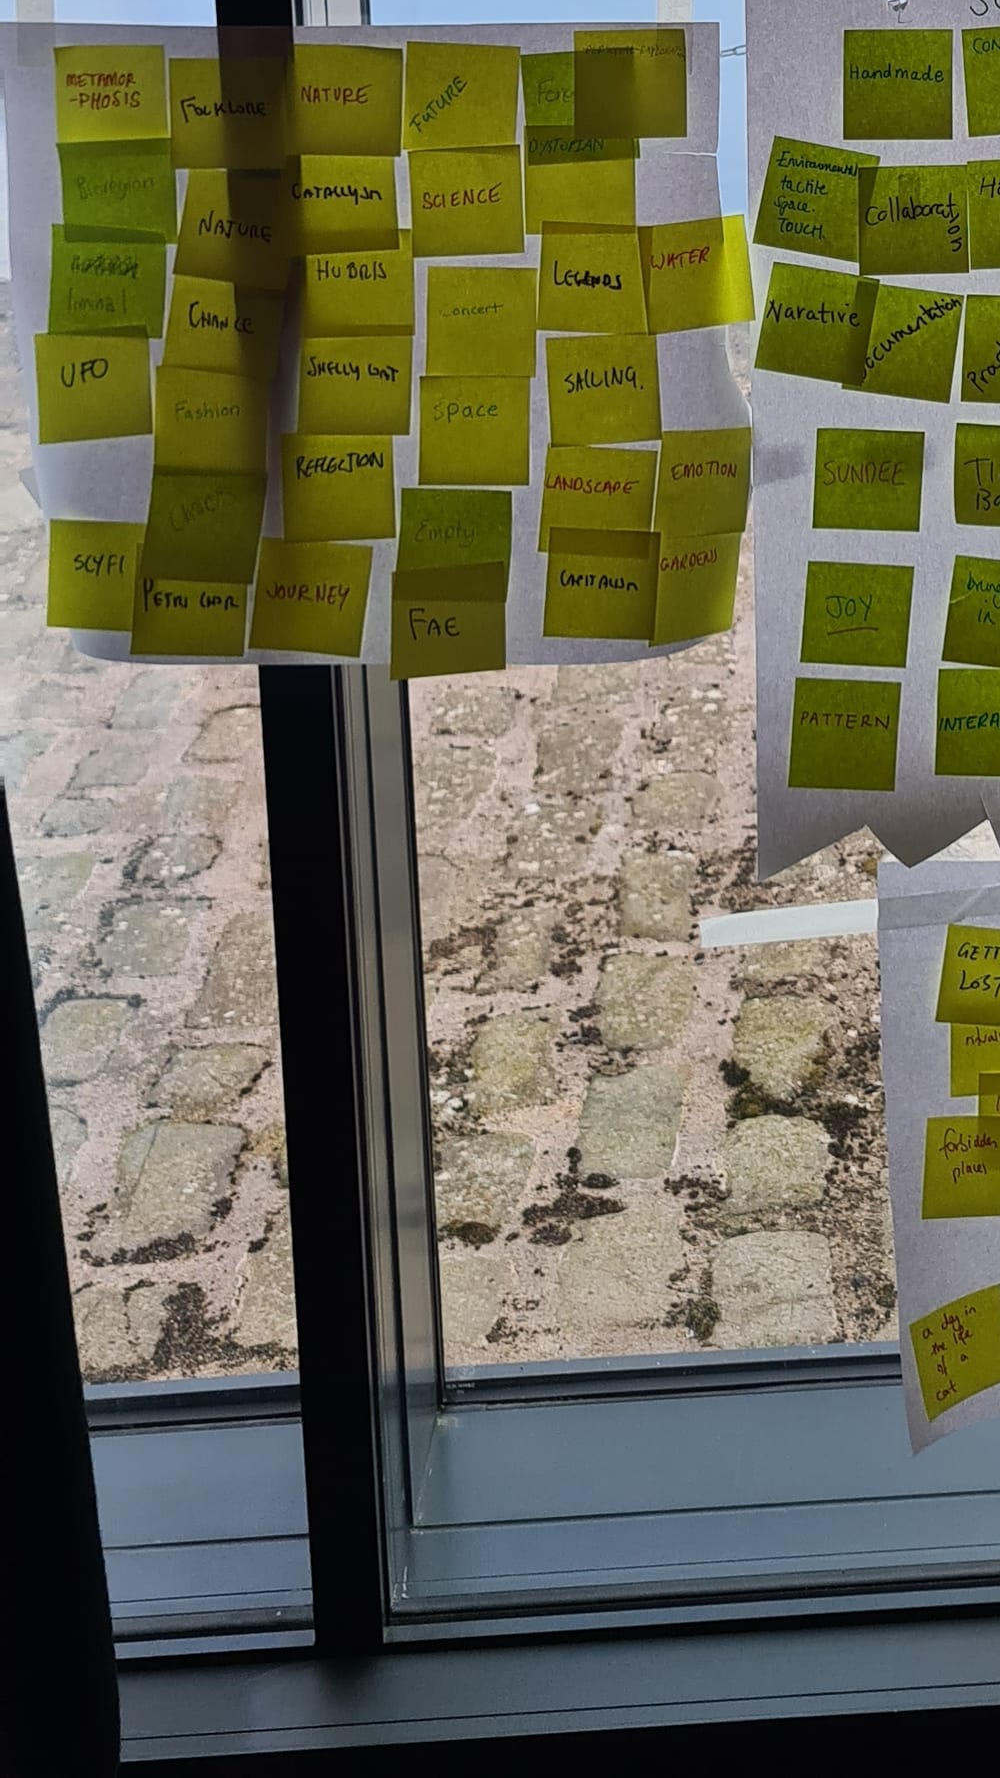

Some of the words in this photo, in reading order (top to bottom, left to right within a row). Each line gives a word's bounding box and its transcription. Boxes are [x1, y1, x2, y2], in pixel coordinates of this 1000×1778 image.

[849, 61, 946, 84] Handmade
[300, 83, 374, 106] NATURE
[407, 74, 469, 134] FUTURE
[421, 181, 503, 211] SCIENCE
[197, 209, 273, 245] NATURE
[764, 299, 861, 328] Narative
[60, 356, 111, 389] UFO
[174, 398, 241, 424] Fashion
[294, 450, 386, 481] REFLECTION
[669, 460, 739, 482] EMOTION
[544, 476, 640, 496] LANDSCAPE
[264, 583, 351, 611] JOURNEY
[824, 593, 873, 622] JOY
[407, 606, 462, 642] FAE
[799, 711, 891, 731] PATTERN
[921, 1326, 935, 1341] a
[963, 1304, 978, 1319] in
[935, 1381, 958, 1403] cat
